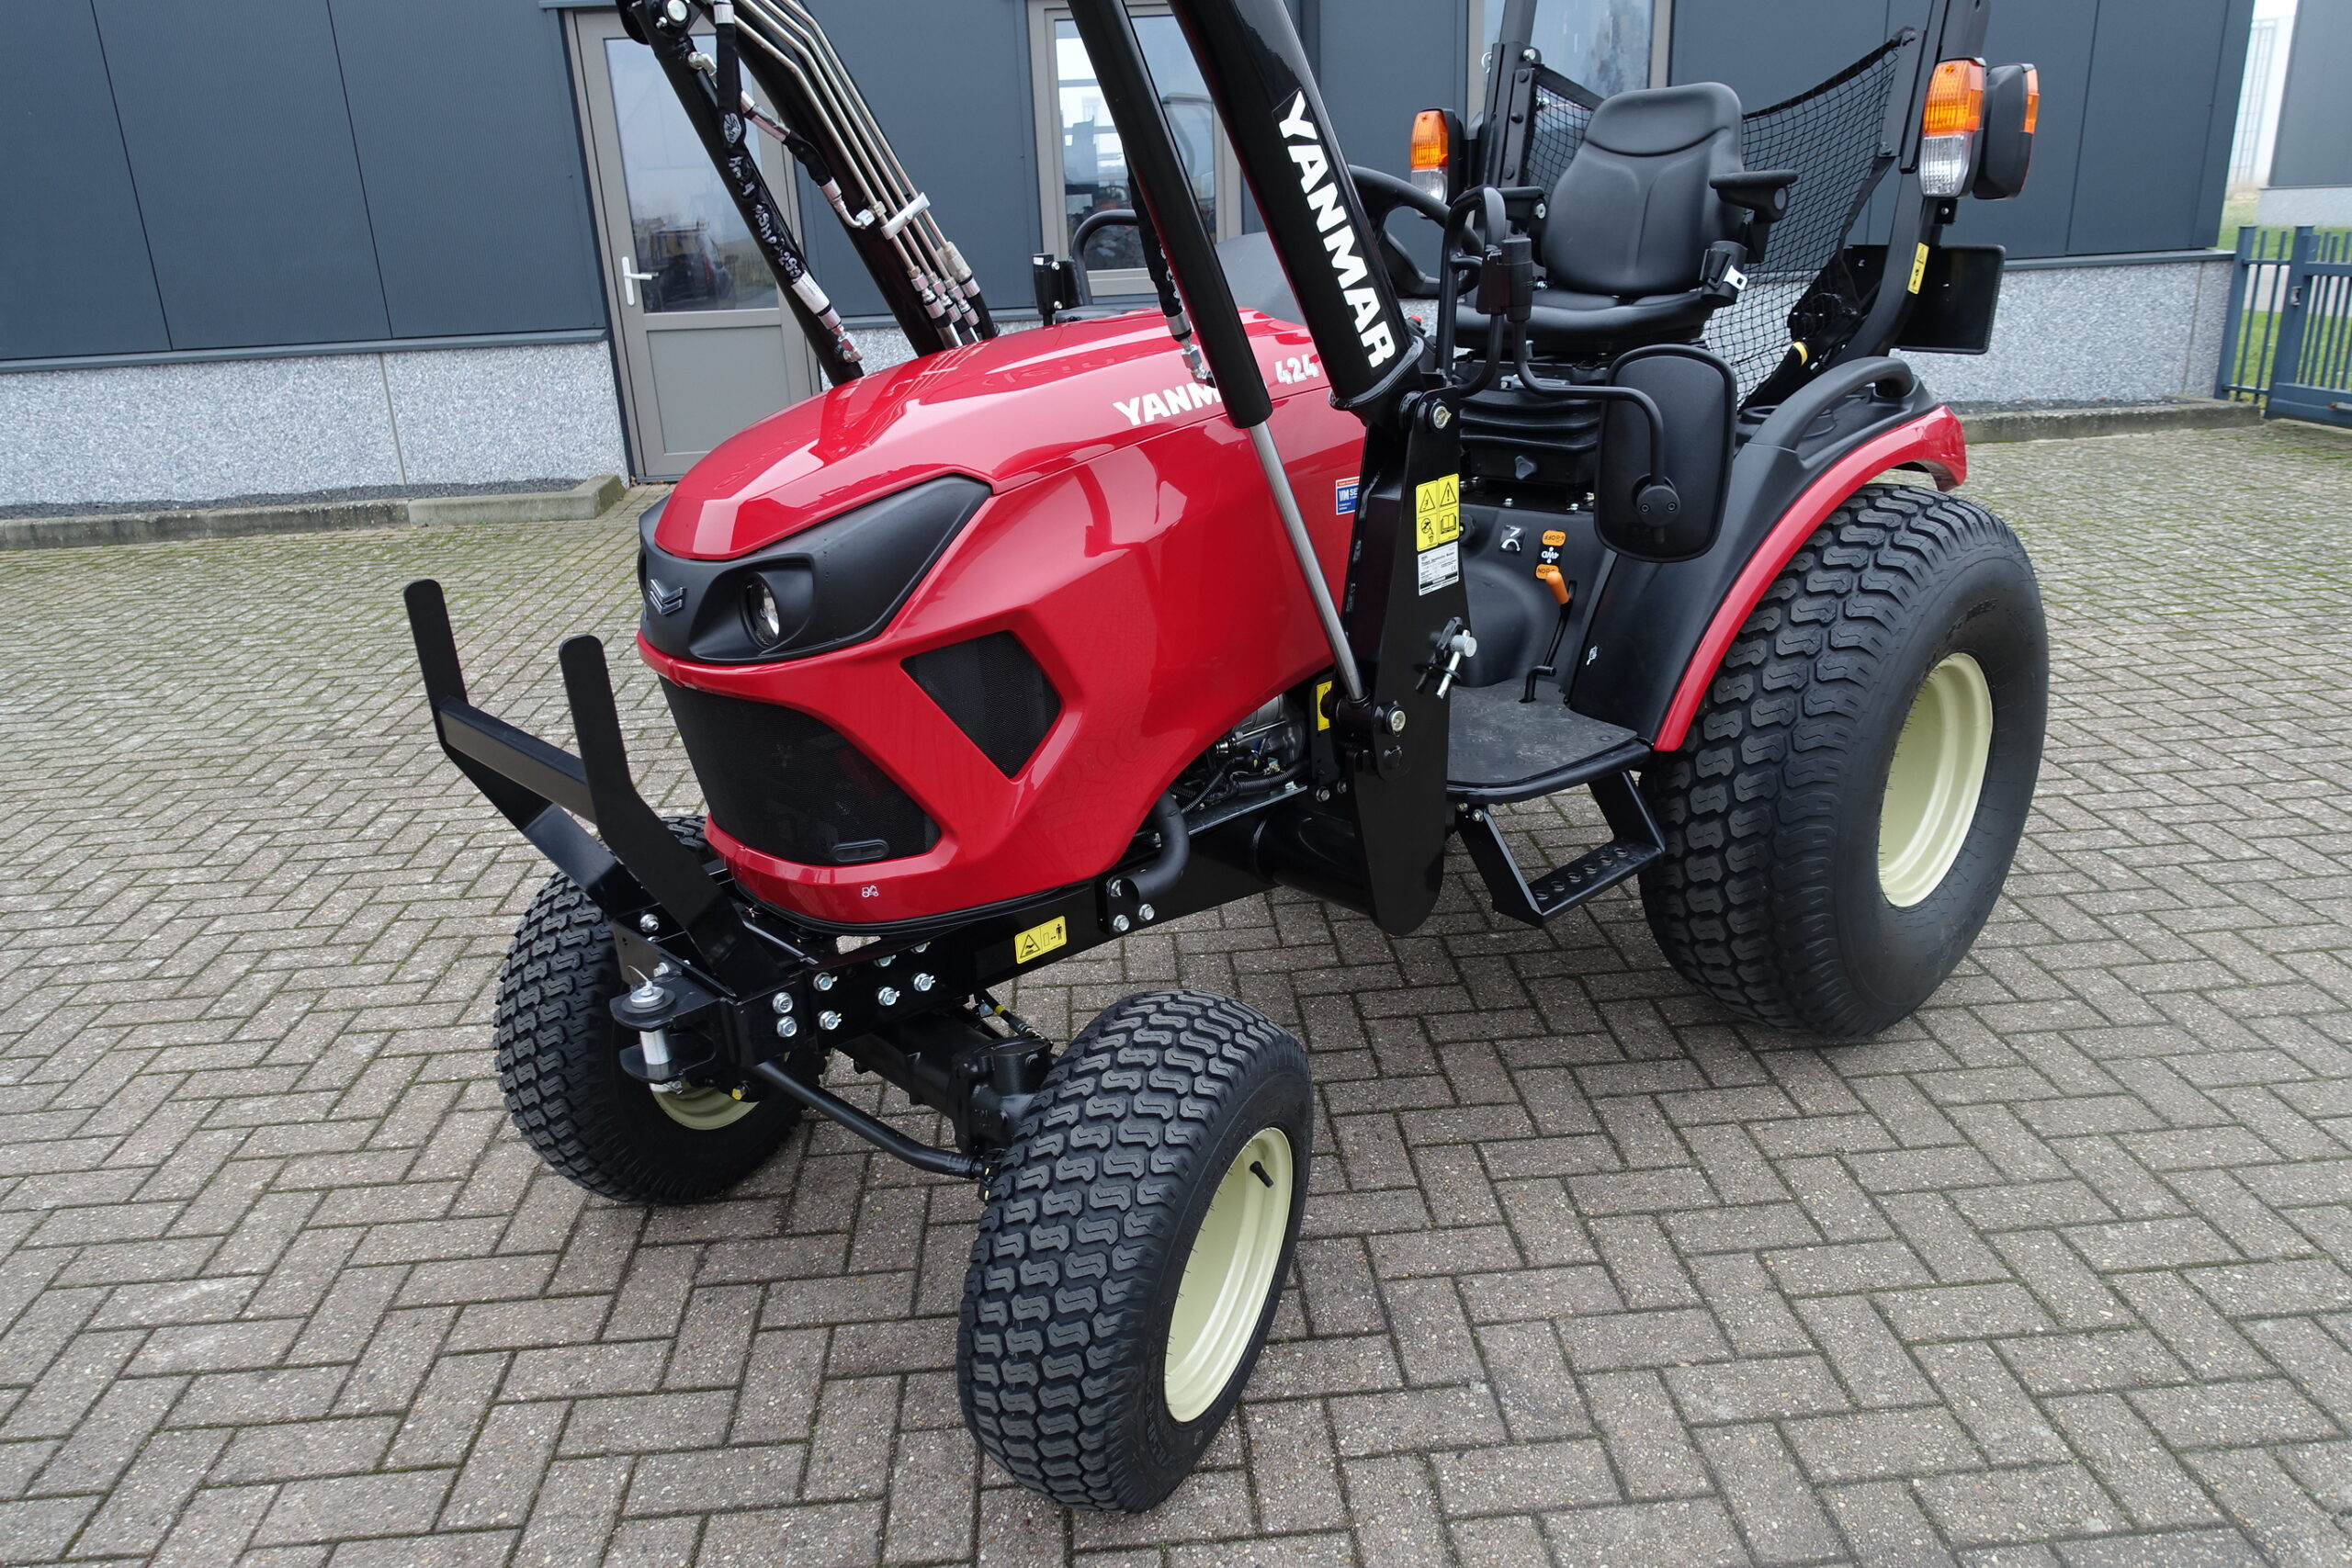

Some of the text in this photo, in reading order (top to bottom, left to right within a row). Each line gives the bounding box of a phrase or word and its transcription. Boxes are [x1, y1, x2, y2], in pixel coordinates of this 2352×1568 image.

[1278, 89, 1396, 368] YANMAR
[1274, 354, 1320, 385] 424
[1541, 550, 1559, 559] 4WD
